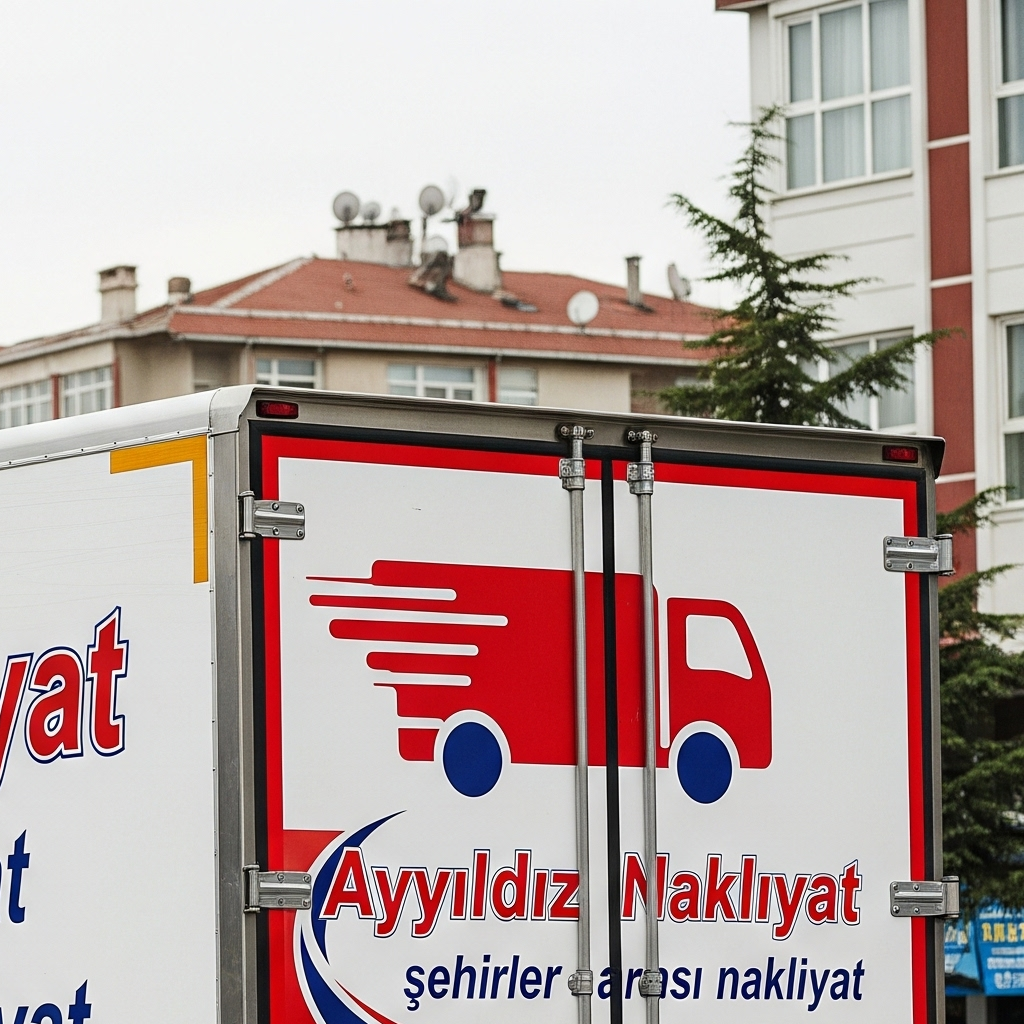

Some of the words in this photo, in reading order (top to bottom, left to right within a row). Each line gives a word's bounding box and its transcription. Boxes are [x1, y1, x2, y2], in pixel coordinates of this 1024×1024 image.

[319, 846, 580, 938] Ayyıldız
[403, 954, 563, 1011] şehirler
[716, 956, 866, 1011] nakliyat
